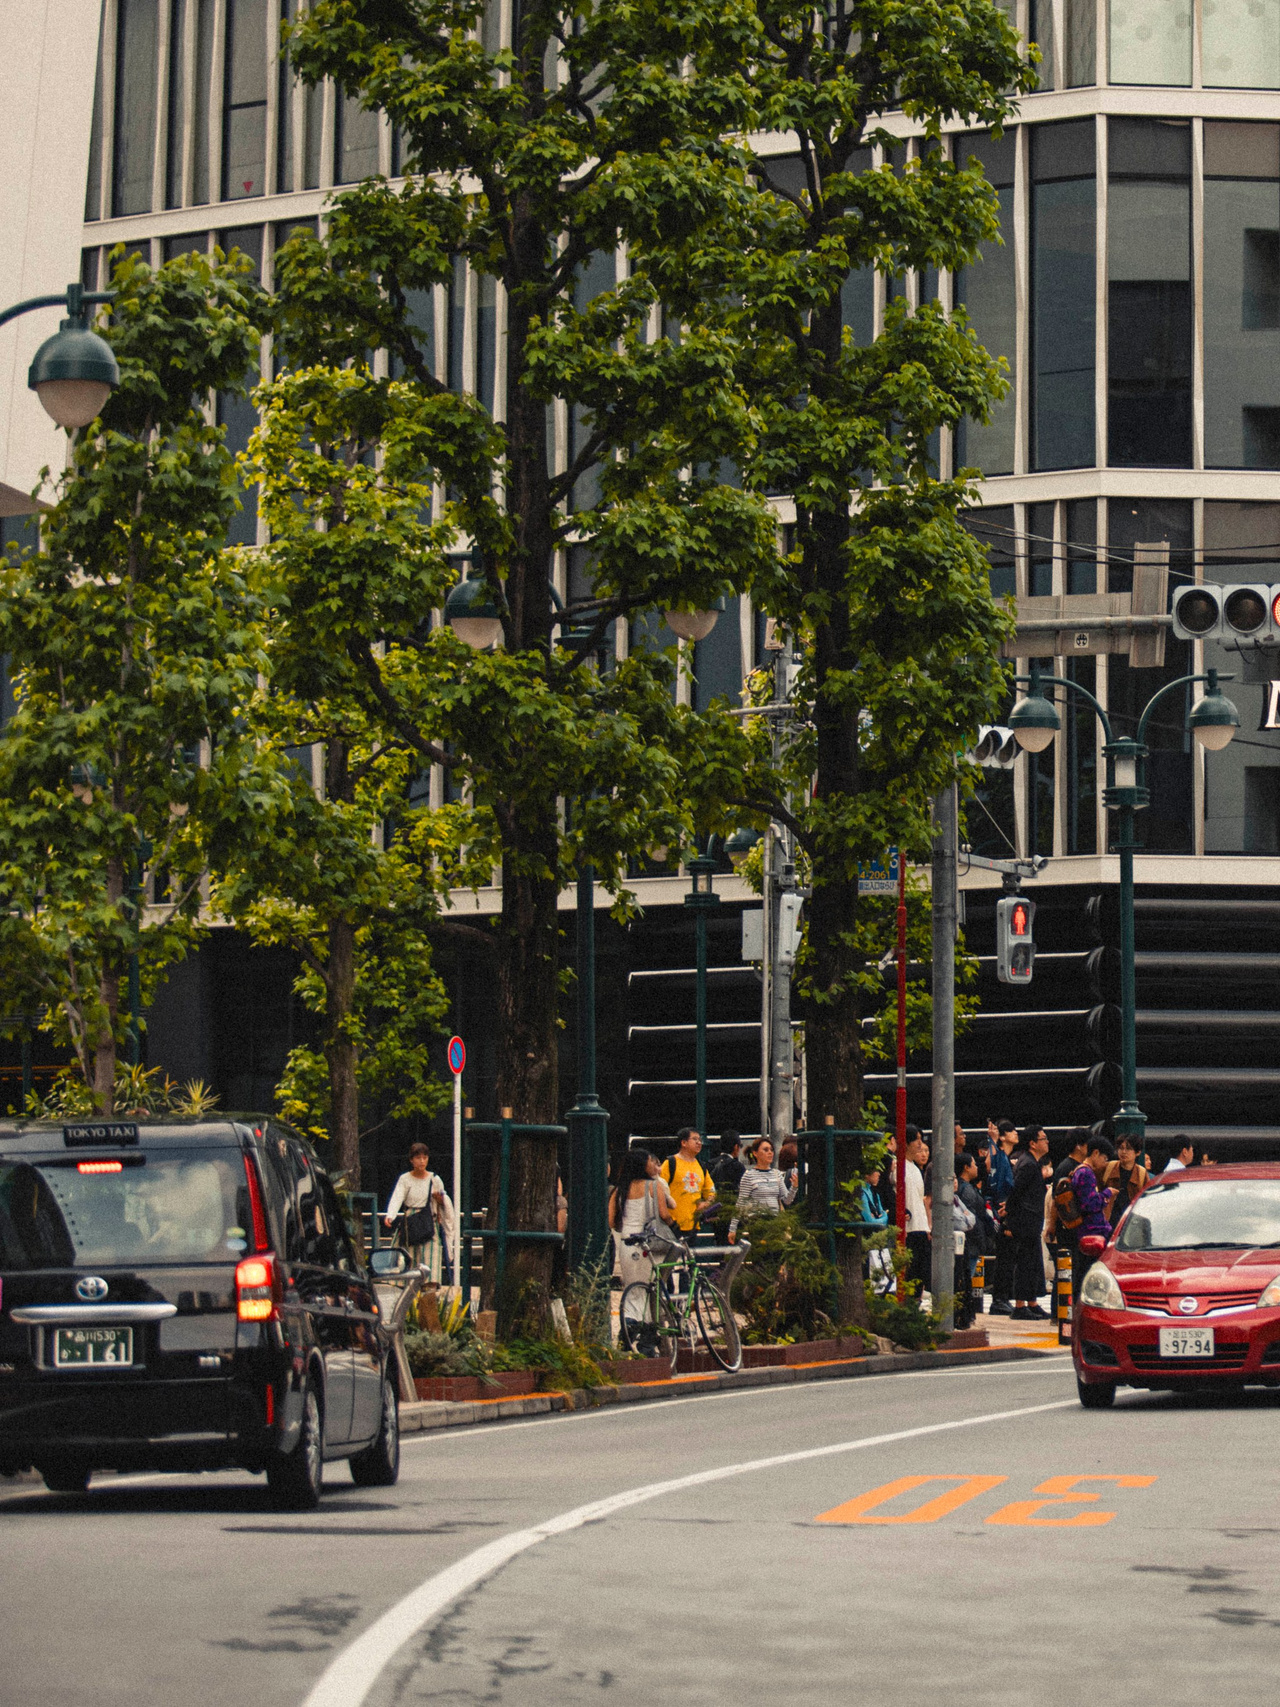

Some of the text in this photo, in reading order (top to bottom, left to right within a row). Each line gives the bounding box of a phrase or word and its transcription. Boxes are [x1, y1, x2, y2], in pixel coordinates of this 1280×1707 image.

[66, 1126, 135, 1139] TOKYO TAXI
[1172, 1339, 1210, 1354] 97-94
[814, 1474, 1159, 1526] 30
